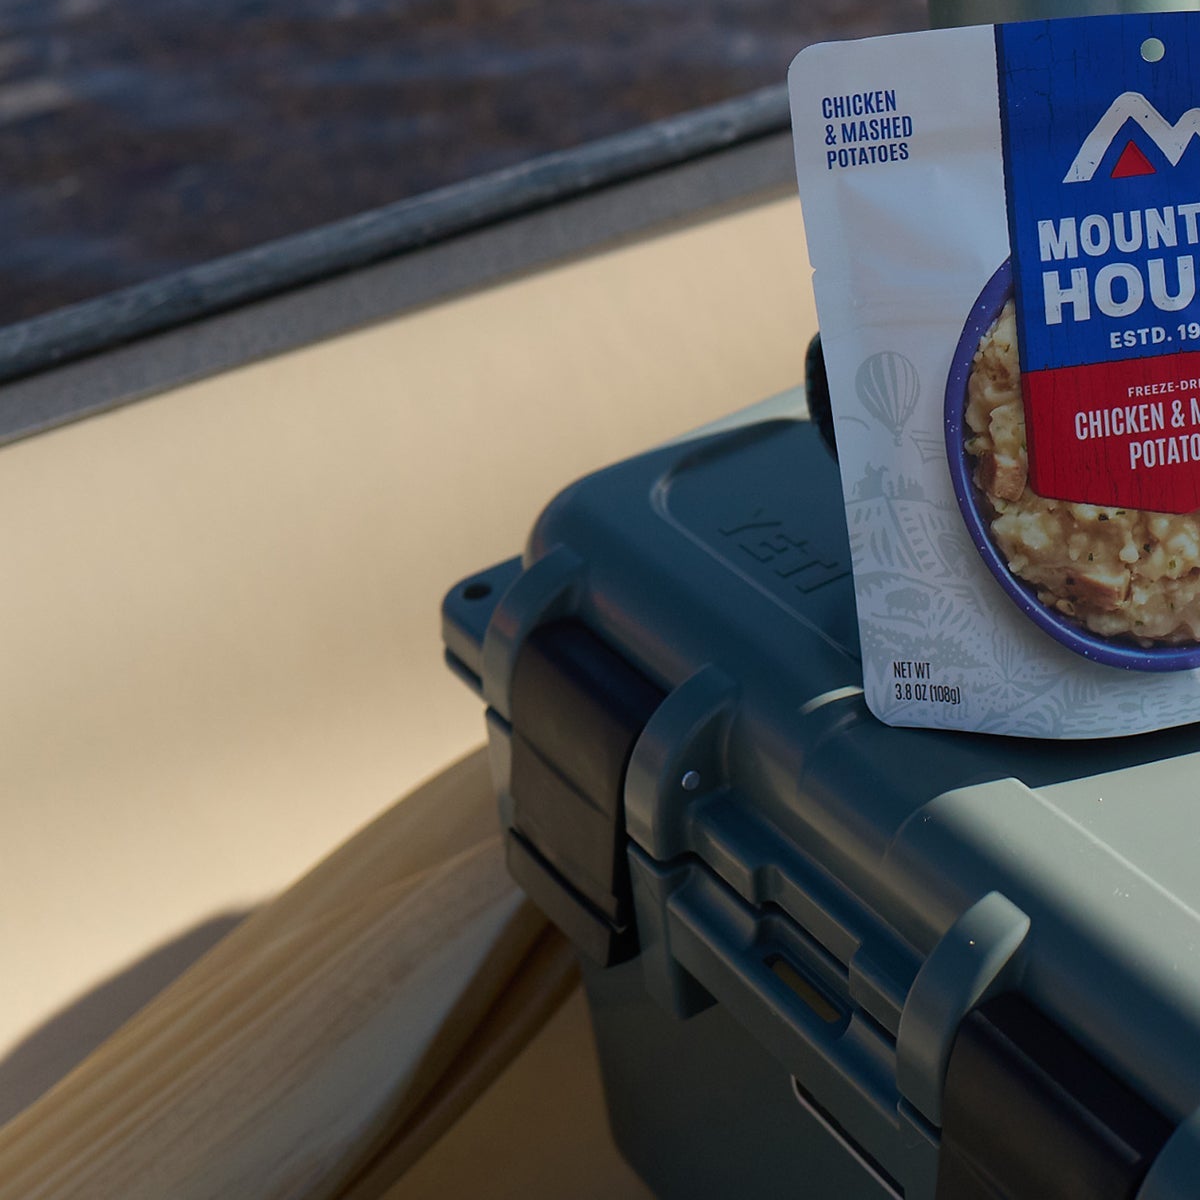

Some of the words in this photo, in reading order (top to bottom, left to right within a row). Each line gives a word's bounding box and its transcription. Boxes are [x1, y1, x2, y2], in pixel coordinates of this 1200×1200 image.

[821, 89, 897, 119] CHICKEN
[825, 124, 837, 145] &
[841, 115, 913, 144] MASHED
[827, 142, 909, 170] POTATOES
[1109, 326, 1173, 349] ESTD.
[1074, 401, 1166, 441] CHICKEN
[1171, 399, 1185, 429] &
[718, 508, 853, 594] YETI
[893, 662, 912, 678] NET
[915, 663, 930, 679] WT
[895, 683, 912, 700] 3.8
[915, 684, 928, 701] OZ
[930, 685, 961, 705] (108g)
